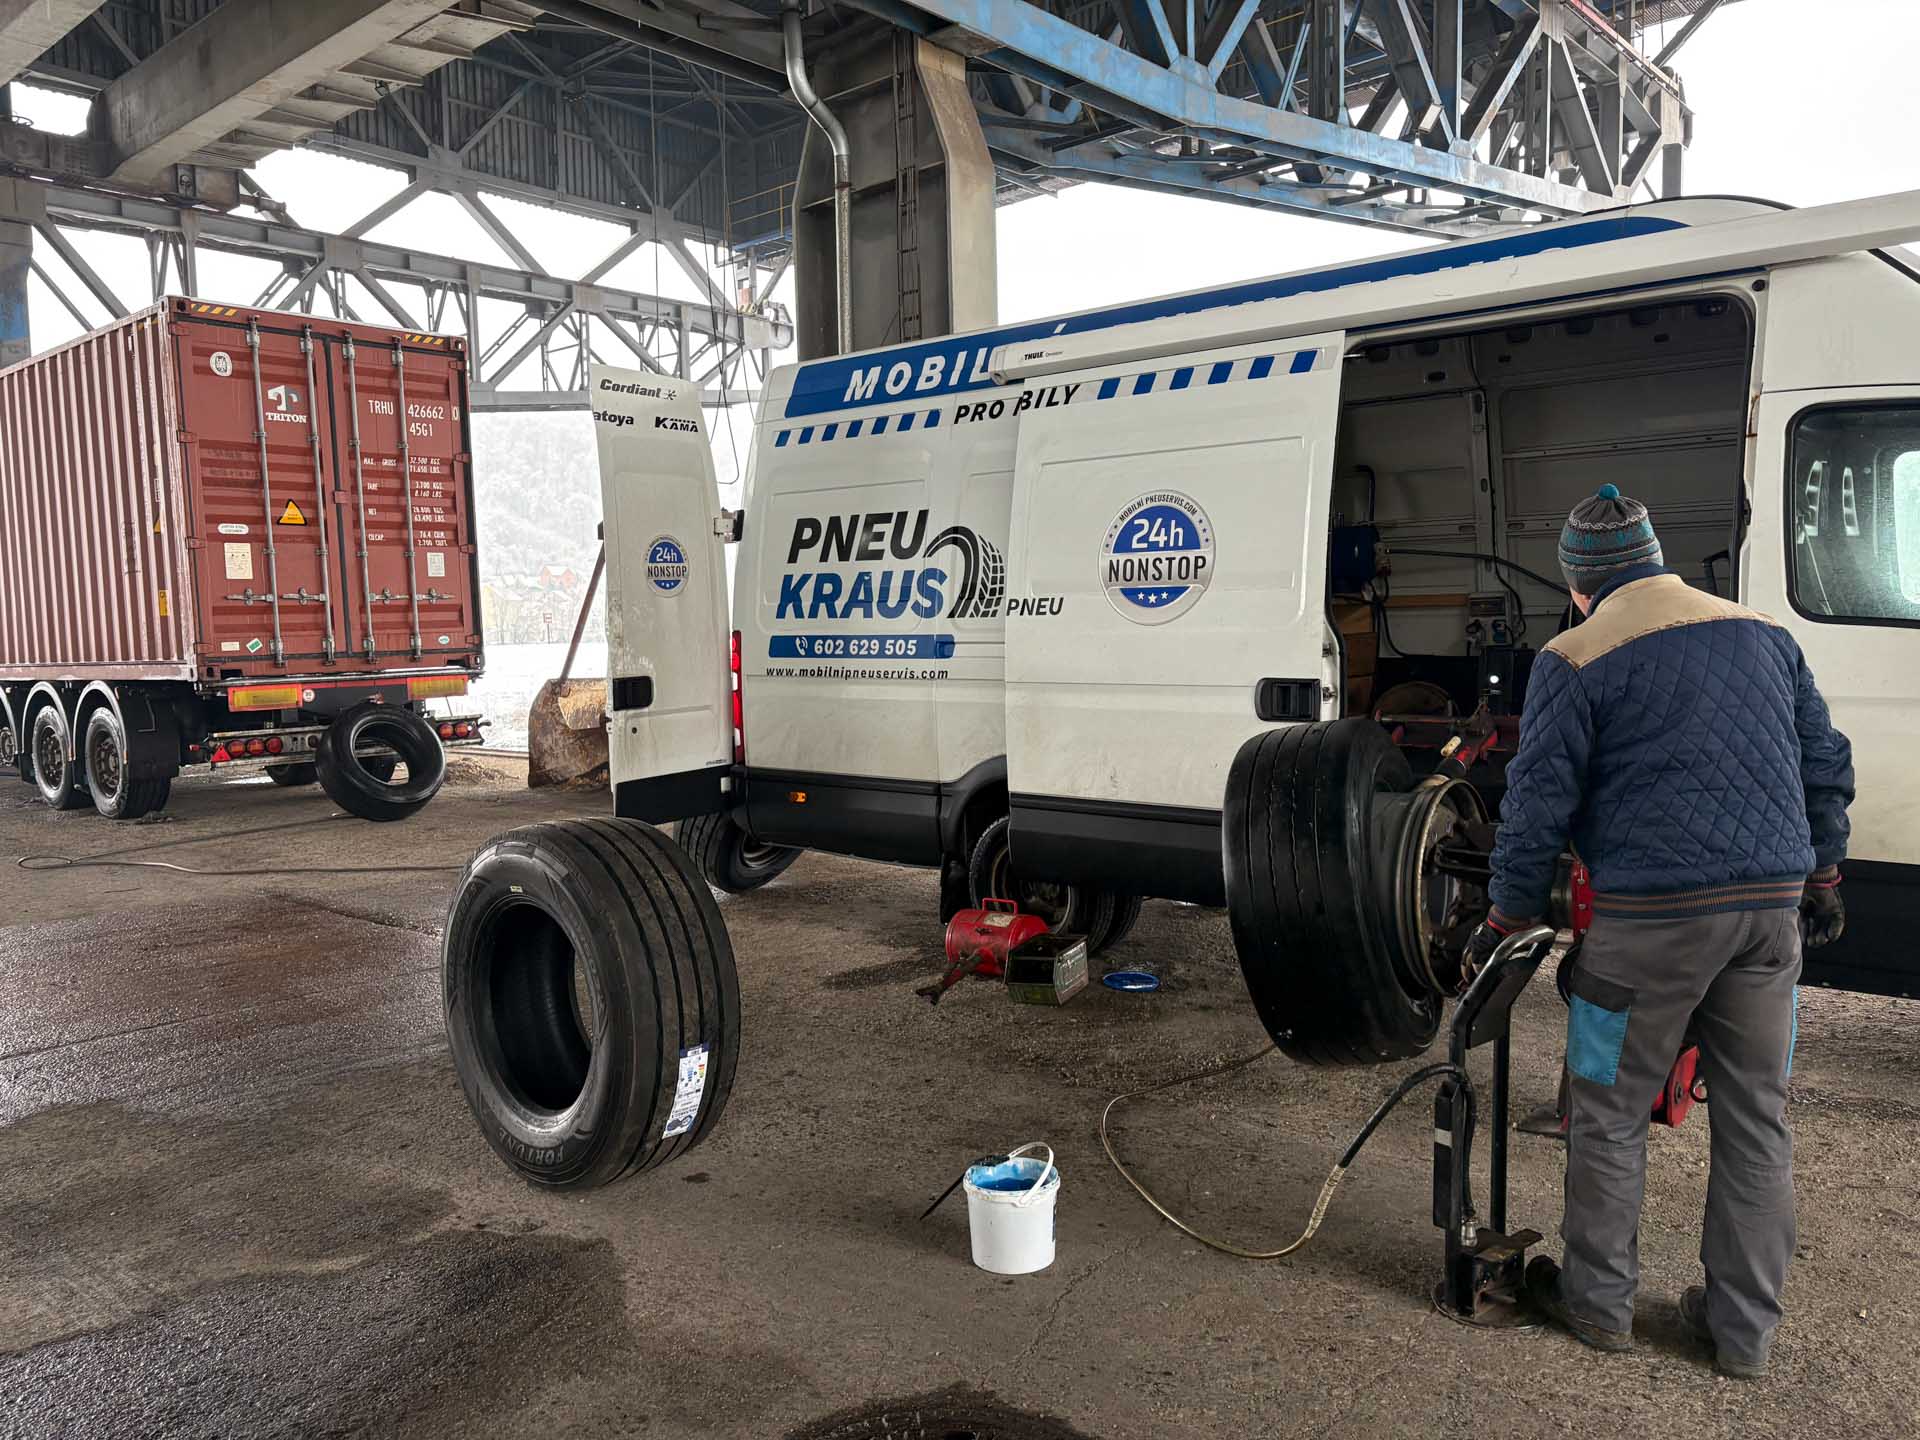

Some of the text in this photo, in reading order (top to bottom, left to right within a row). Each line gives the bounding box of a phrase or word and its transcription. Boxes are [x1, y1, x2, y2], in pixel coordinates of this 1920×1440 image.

[1024, 352, 1043, 360] THULE
[600, 379, 661, 398] Cordiant
[265, 412, 307, 423] TRITON
[368, 400, 394, 415] TRHU
[408, 403, 444, 419] 426662
[954, 399, 1004, 425] PRO
[409, 422, 433, 436] 45G1
[654, 416, 699, 432] KAMA
[787, 509, 929, 564] PNEU
[1131, 518, 1184, 549] 24h
[655, 547, 678, 562] 24h
[647, 565, 687, 577] NONSTOP
[1108, 556, 1207, 582] NONSTOP
[776, 568, 948, 619] KRAUS
[1006, 597, 1064, 616] PNEU
[814, 639, 917, 655] 602 629 505
[766, 666, 949, 680] www.mobilnipneuservis.com
